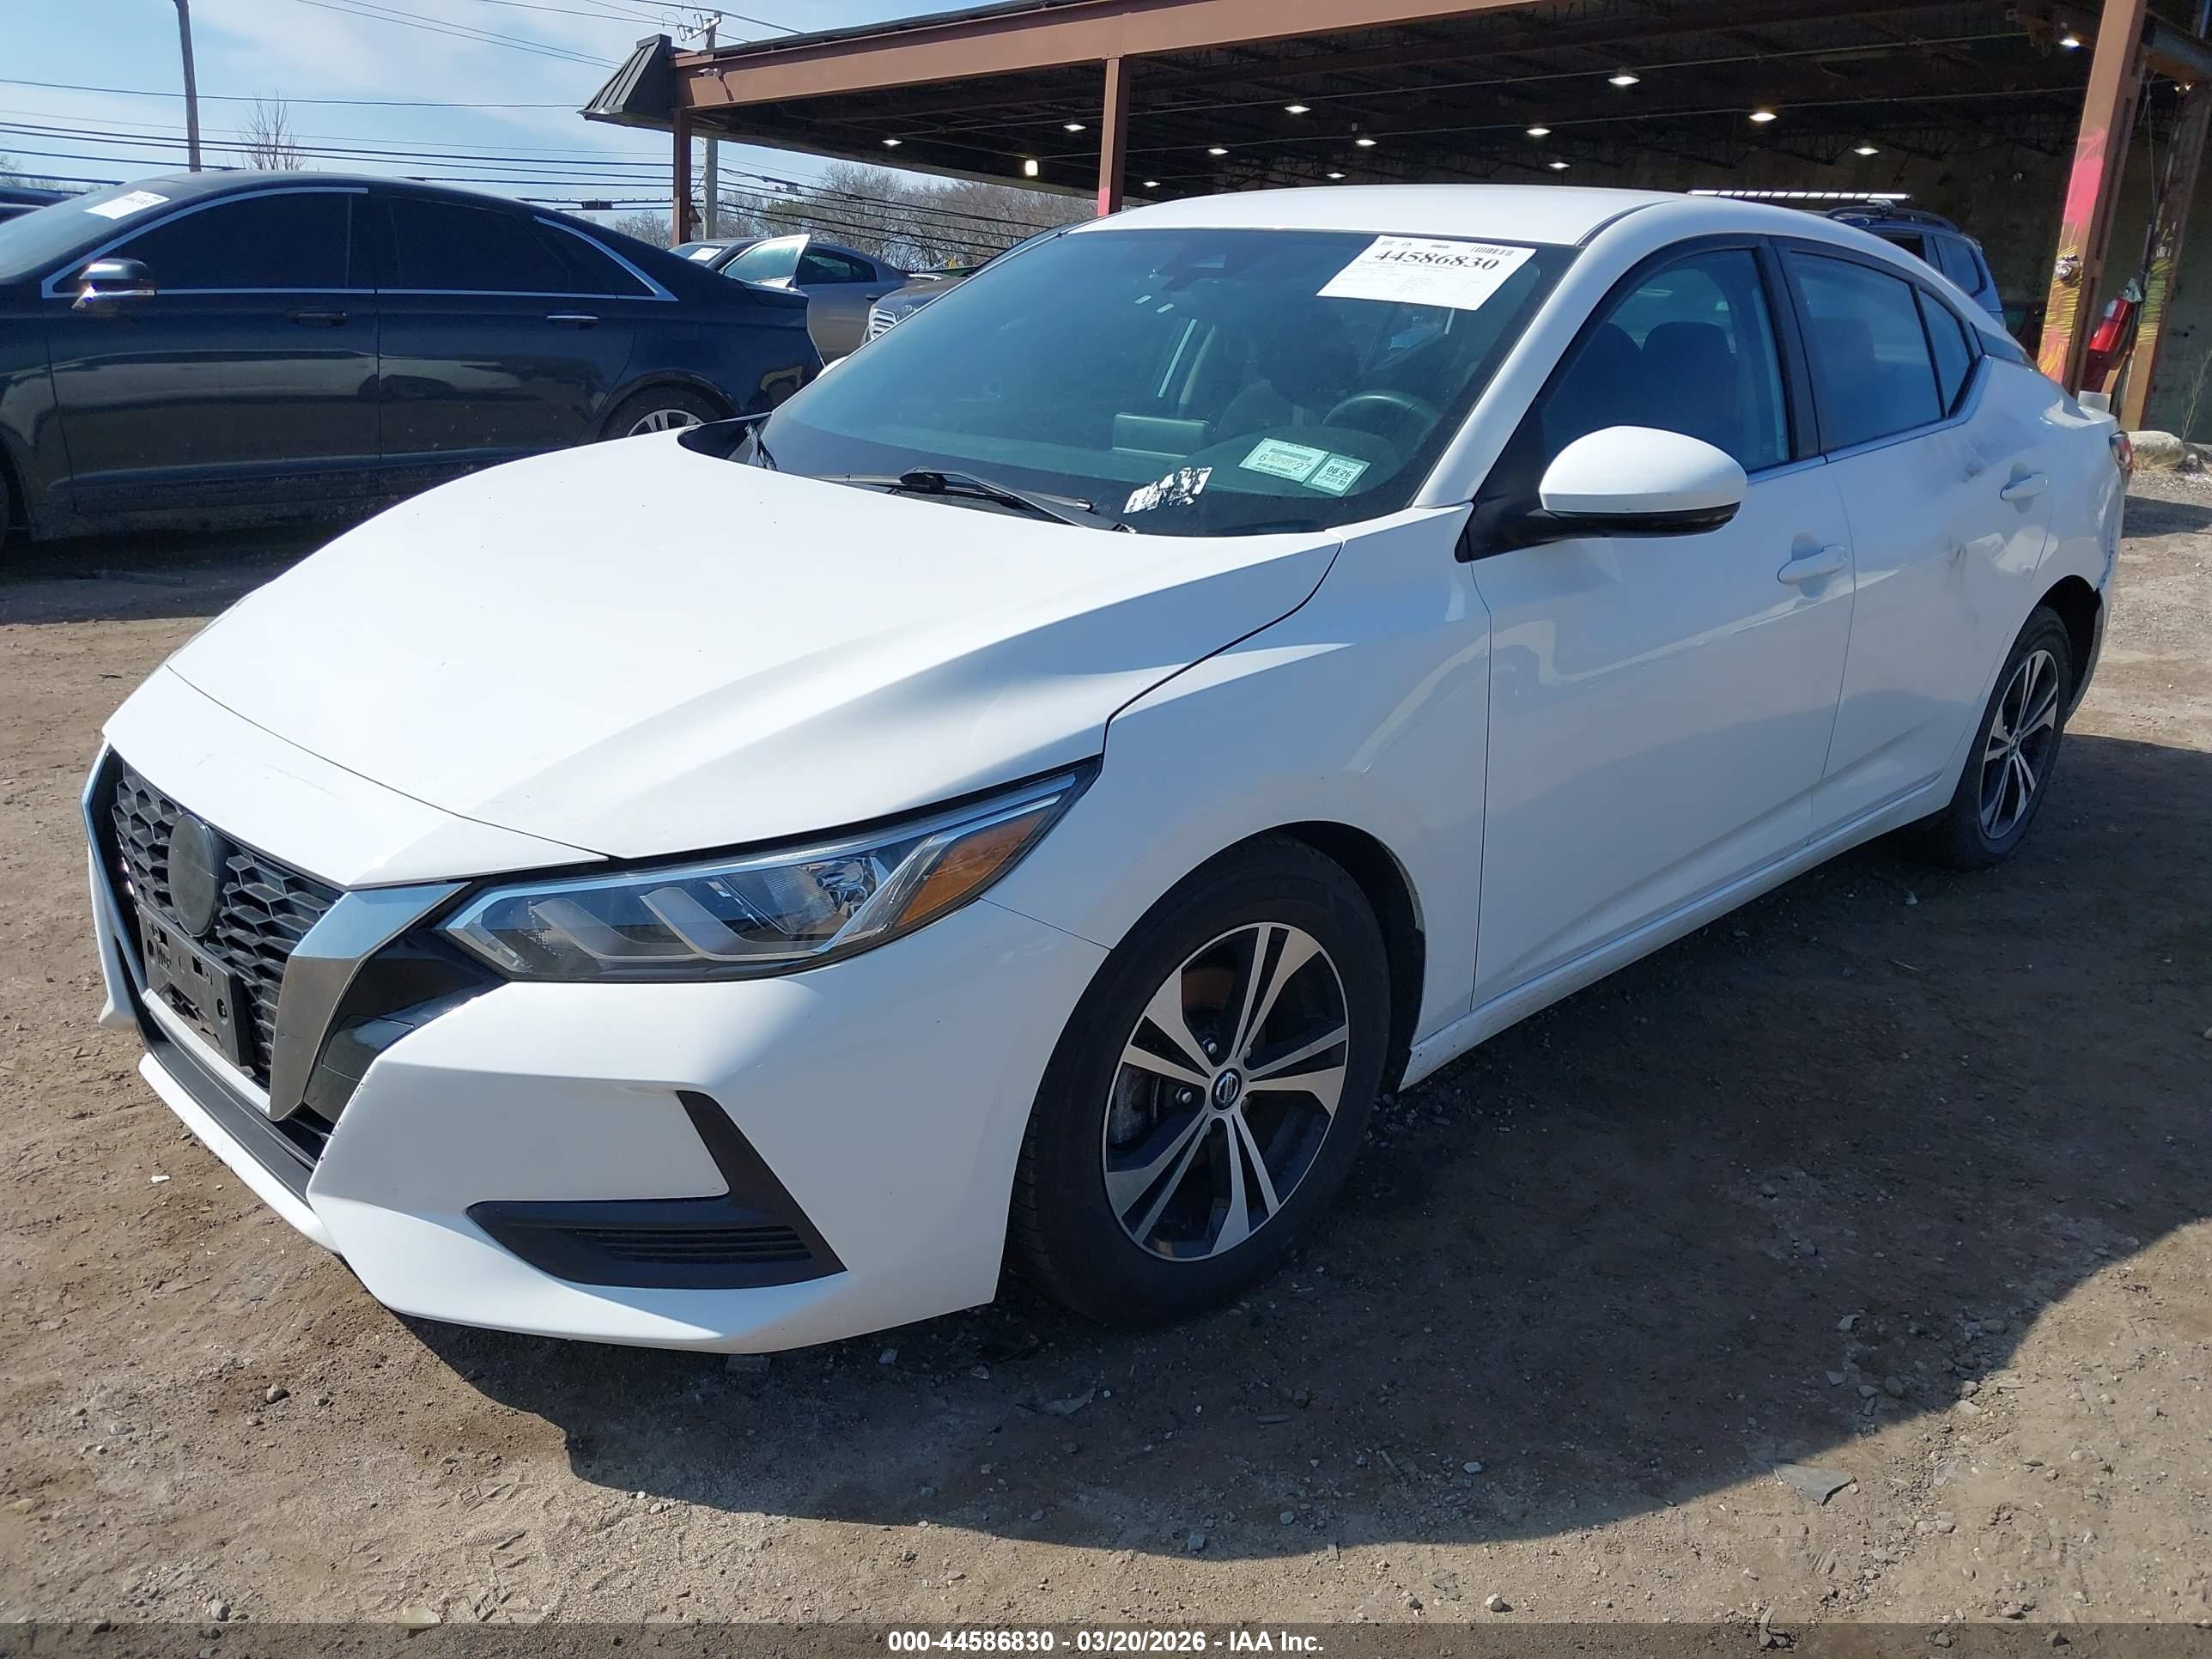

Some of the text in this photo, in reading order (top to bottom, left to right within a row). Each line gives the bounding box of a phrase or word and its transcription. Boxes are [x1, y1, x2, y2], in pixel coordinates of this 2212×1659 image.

[1375, 250, 1499, 270] 44586830
[1258, 453, 1269, 463] 6
[1294, 462, 1313, 472] 27
